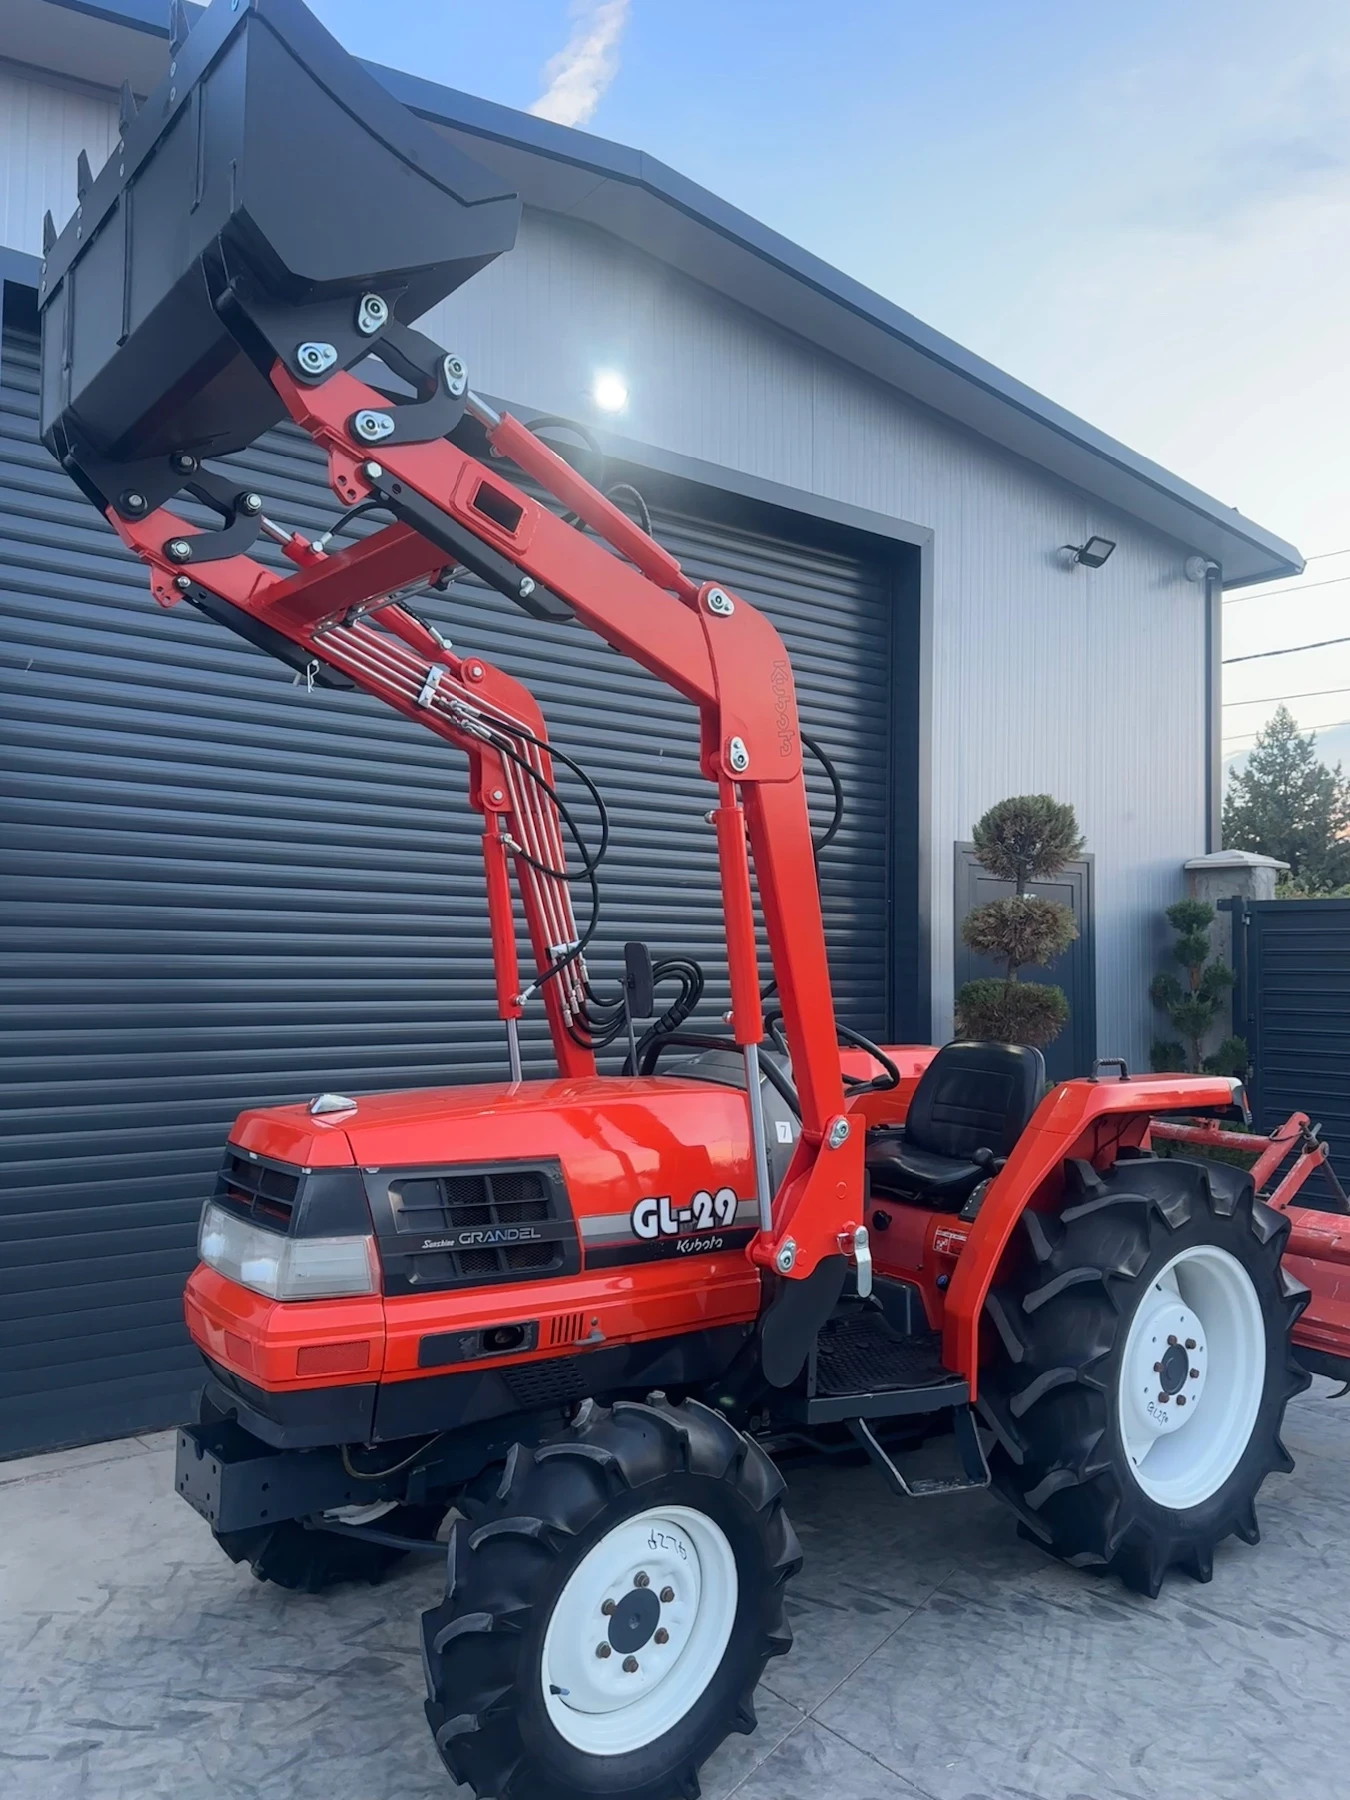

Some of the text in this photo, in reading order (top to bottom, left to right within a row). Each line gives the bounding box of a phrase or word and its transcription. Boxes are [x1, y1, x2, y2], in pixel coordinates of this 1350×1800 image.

[770, 660, 796, 758] Kubota
[779, 1124, 788, 1140] 7
[631, 1187, 738, 1240] GL-29
[421, 1227, 542, 1249] Sunshine GRANDEL
[676, 1235, 724, 1254] Kubota
